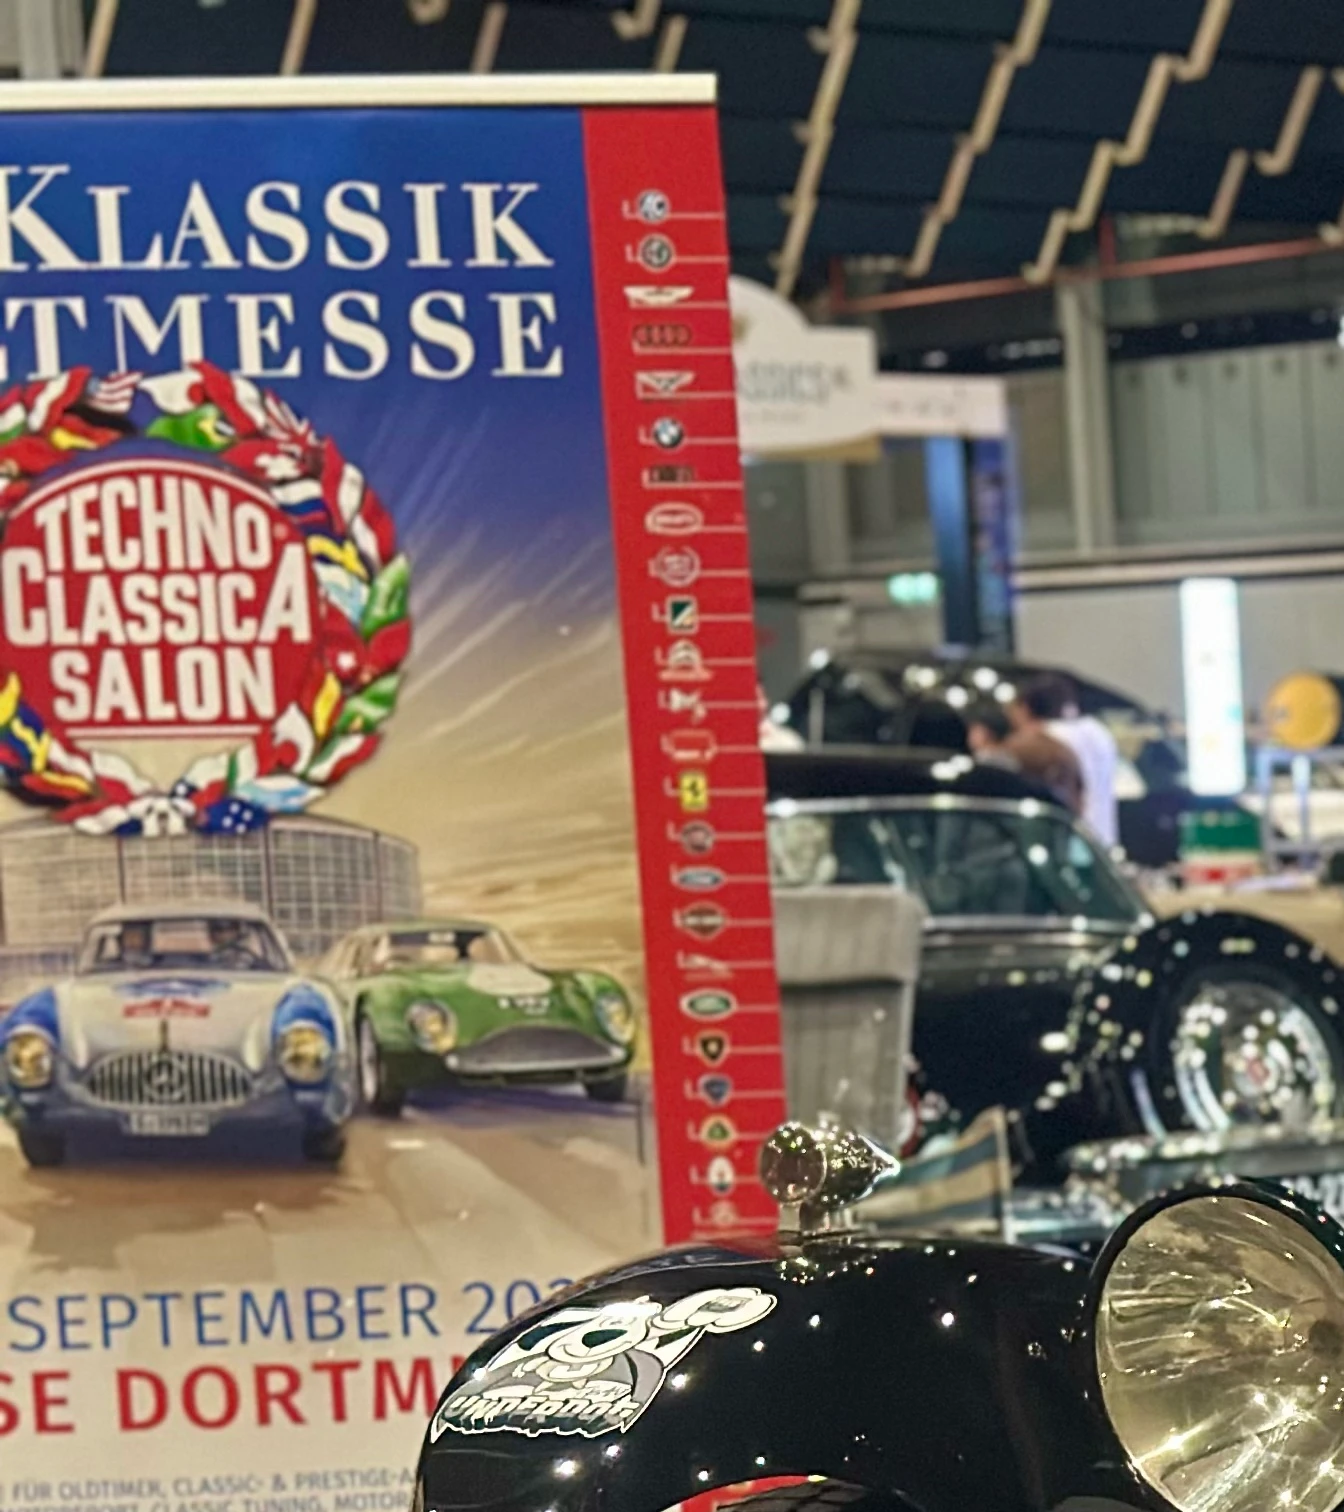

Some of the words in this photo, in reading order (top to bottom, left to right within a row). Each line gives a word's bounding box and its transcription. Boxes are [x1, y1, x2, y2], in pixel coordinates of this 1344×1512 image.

[0, 163, 555, 272] KLASSIK
[0, 291, 565, 382] TMESSE
[33, 471, 271, 573] TECHNO
[3, 542, 311, 648] CLASSICA
[51, 646, 276, 723] SALON
[9, 1282, 441, 1352] SEPTEMBER
[117, 1356, 464, 1432] DORTM
[271, 1473, 287, 1492] &
